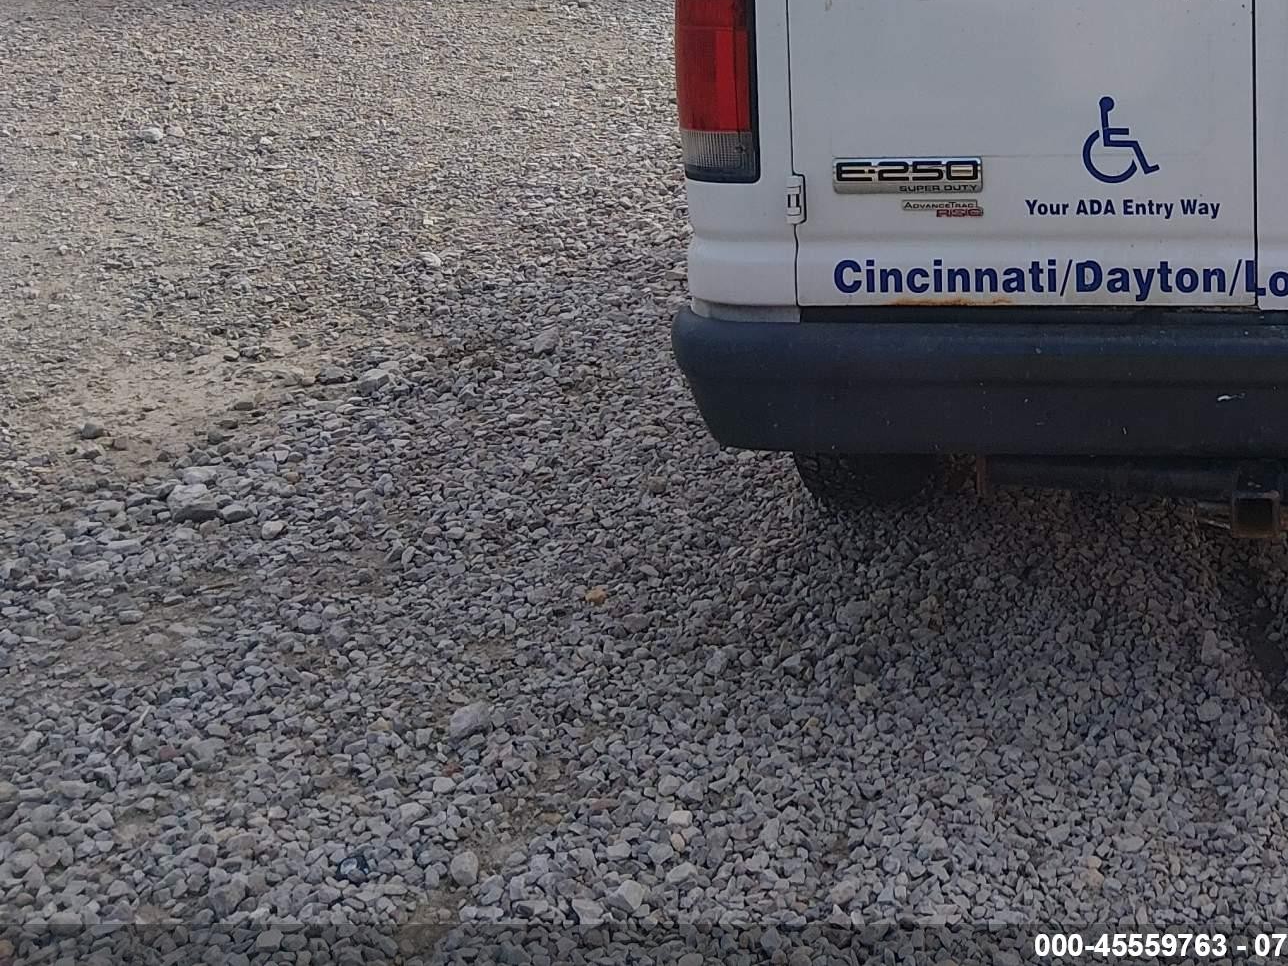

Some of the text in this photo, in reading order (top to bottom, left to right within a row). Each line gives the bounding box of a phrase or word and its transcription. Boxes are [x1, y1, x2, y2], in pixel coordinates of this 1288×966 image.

[836, 161, 978, 181] E-250
[1025, 199, 1221, 219] Your ADA Entry Way
